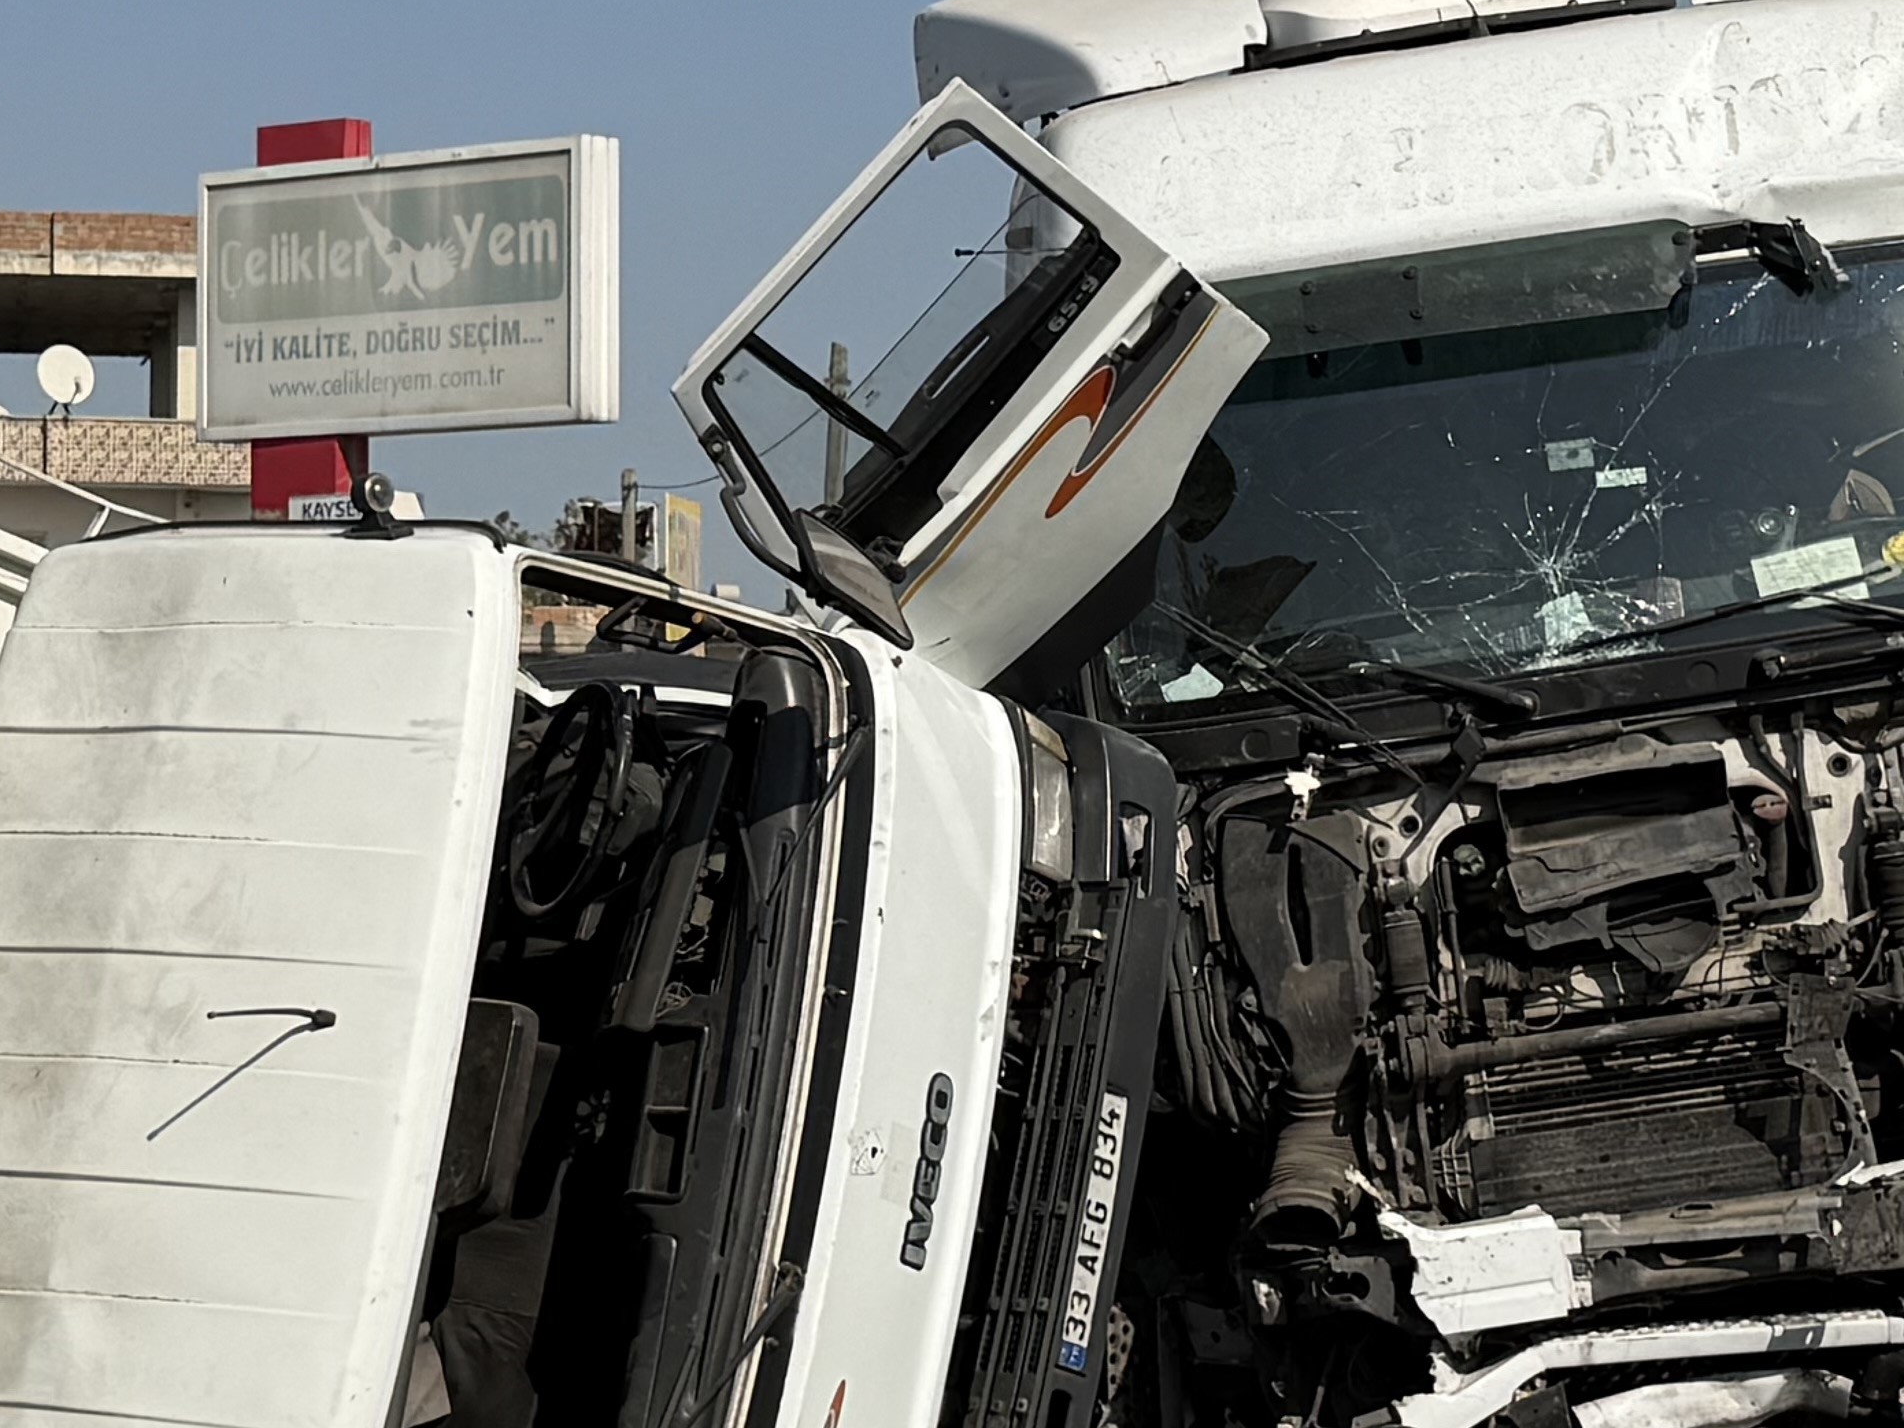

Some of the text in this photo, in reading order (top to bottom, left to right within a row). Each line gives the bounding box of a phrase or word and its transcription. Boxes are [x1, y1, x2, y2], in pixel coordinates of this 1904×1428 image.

[221, 212, 558, 300] Çelikler Yem
[272, 326, 357, 362] KALİTE,
[365, 321, 442, 355] DOĞRU
[269, 364, 505, 399] www.celikleryem.com.tr
[302, 501, 361, 519] KAYSE
[900, 1072, 954, 1272] IVECO
[1066, 1106, 1121, 1341] 33 AFG 834
